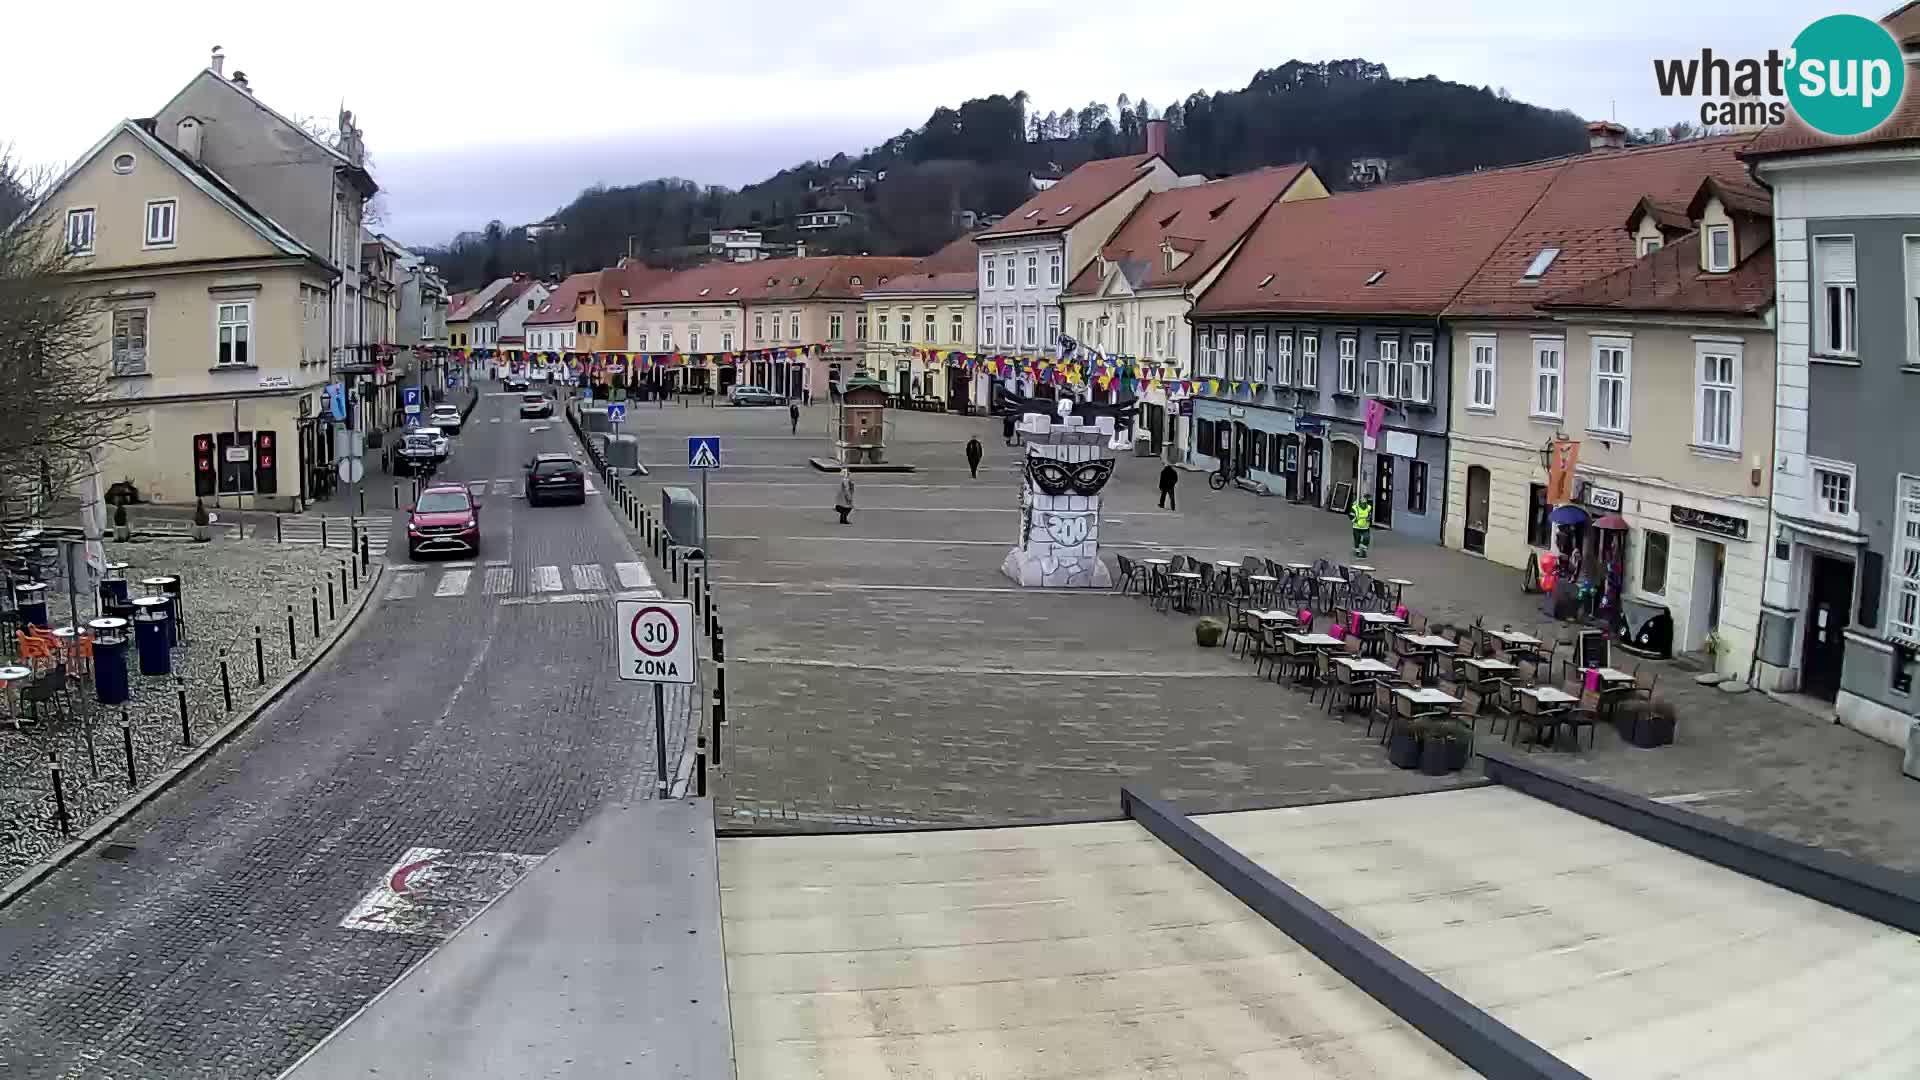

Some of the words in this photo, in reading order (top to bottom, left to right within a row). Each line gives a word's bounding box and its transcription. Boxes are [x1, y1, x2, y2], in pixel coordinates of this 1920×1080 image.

[408, 391, 417, 403] P
[643, 622, 668, 644] 30
[634, 659, 679, 677] ZONA
